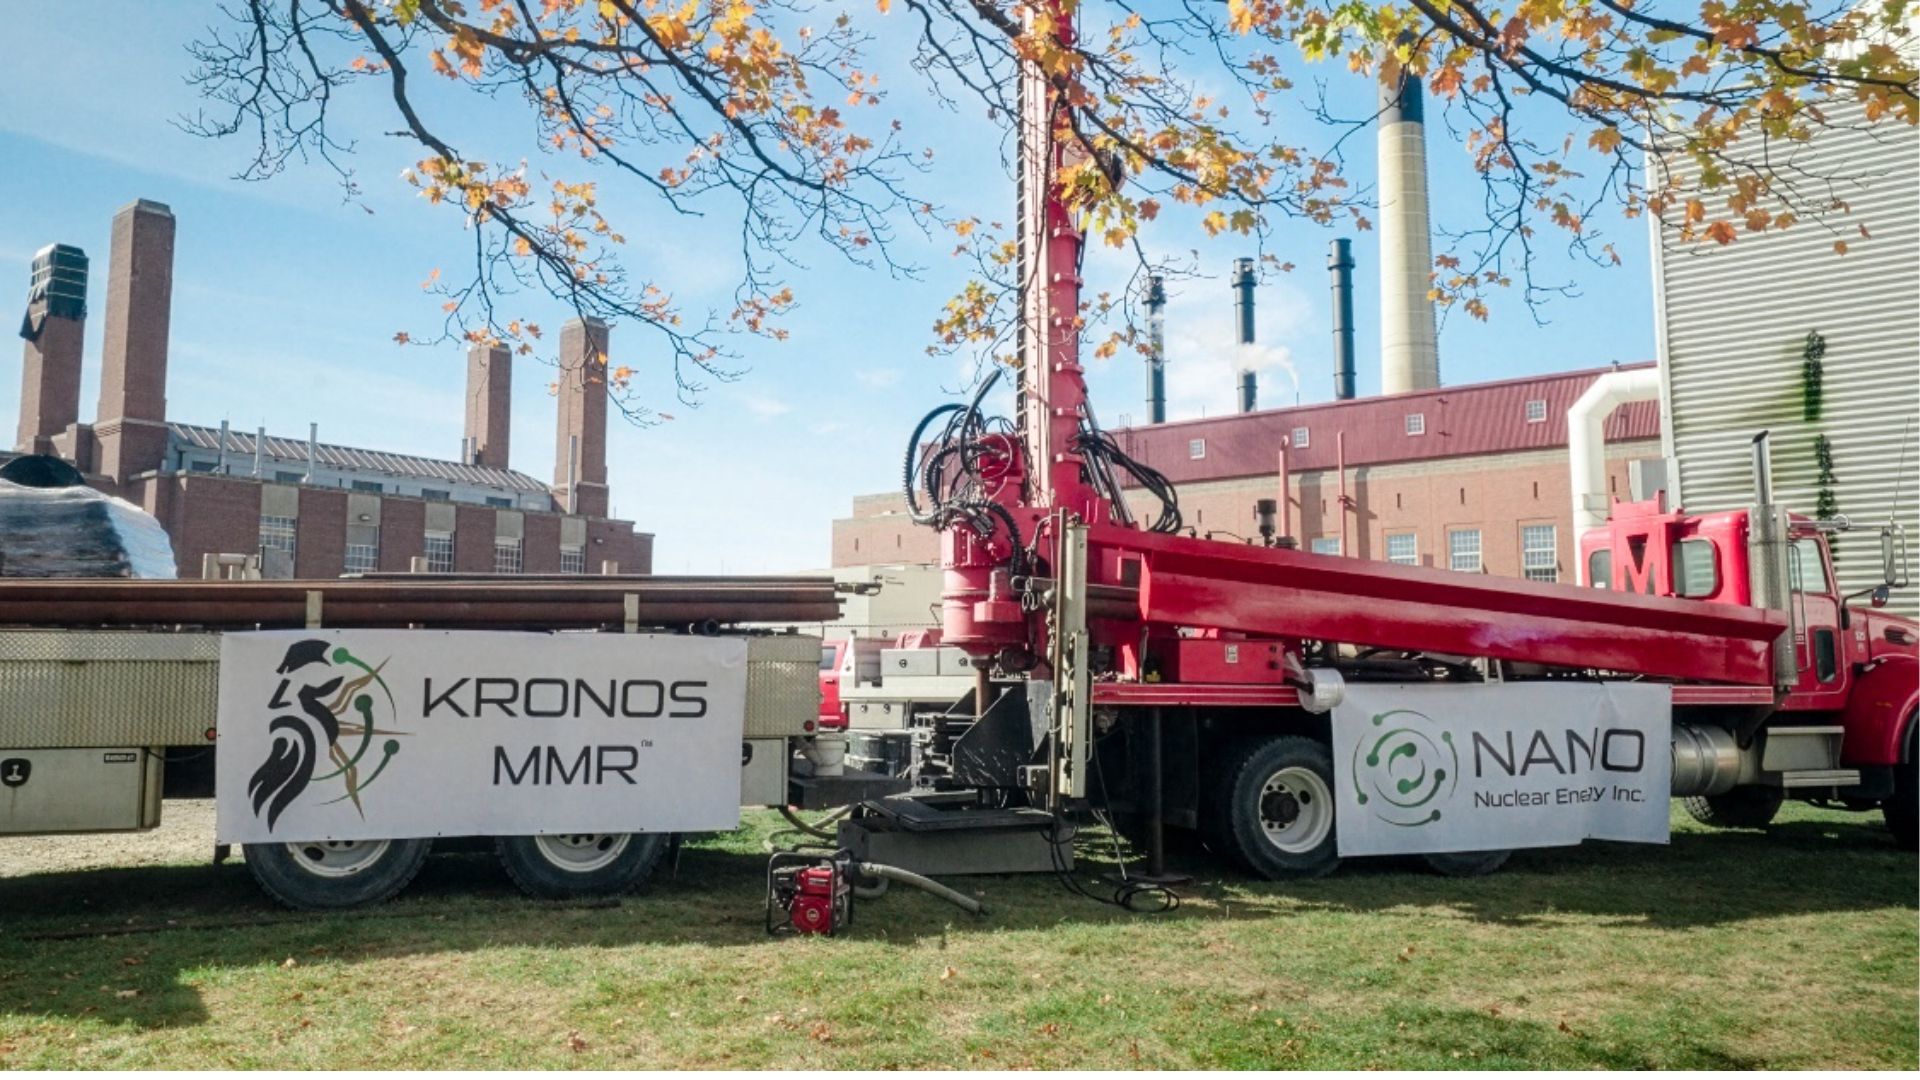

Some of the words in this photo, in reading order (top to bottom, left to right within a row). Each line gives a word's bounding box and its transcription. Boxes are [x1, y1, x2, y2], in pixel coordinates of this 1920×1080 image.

[422, 677, 708, 718] KRONOS
[493, 745, 638, 785] MMR
[1472, 727, 1645, 778] NANO
[1474, 789, 1551, 808] Nuclear
[1556, 785, 1607, 804] Eney
[1612, 785, 1646, 803] Inc.
